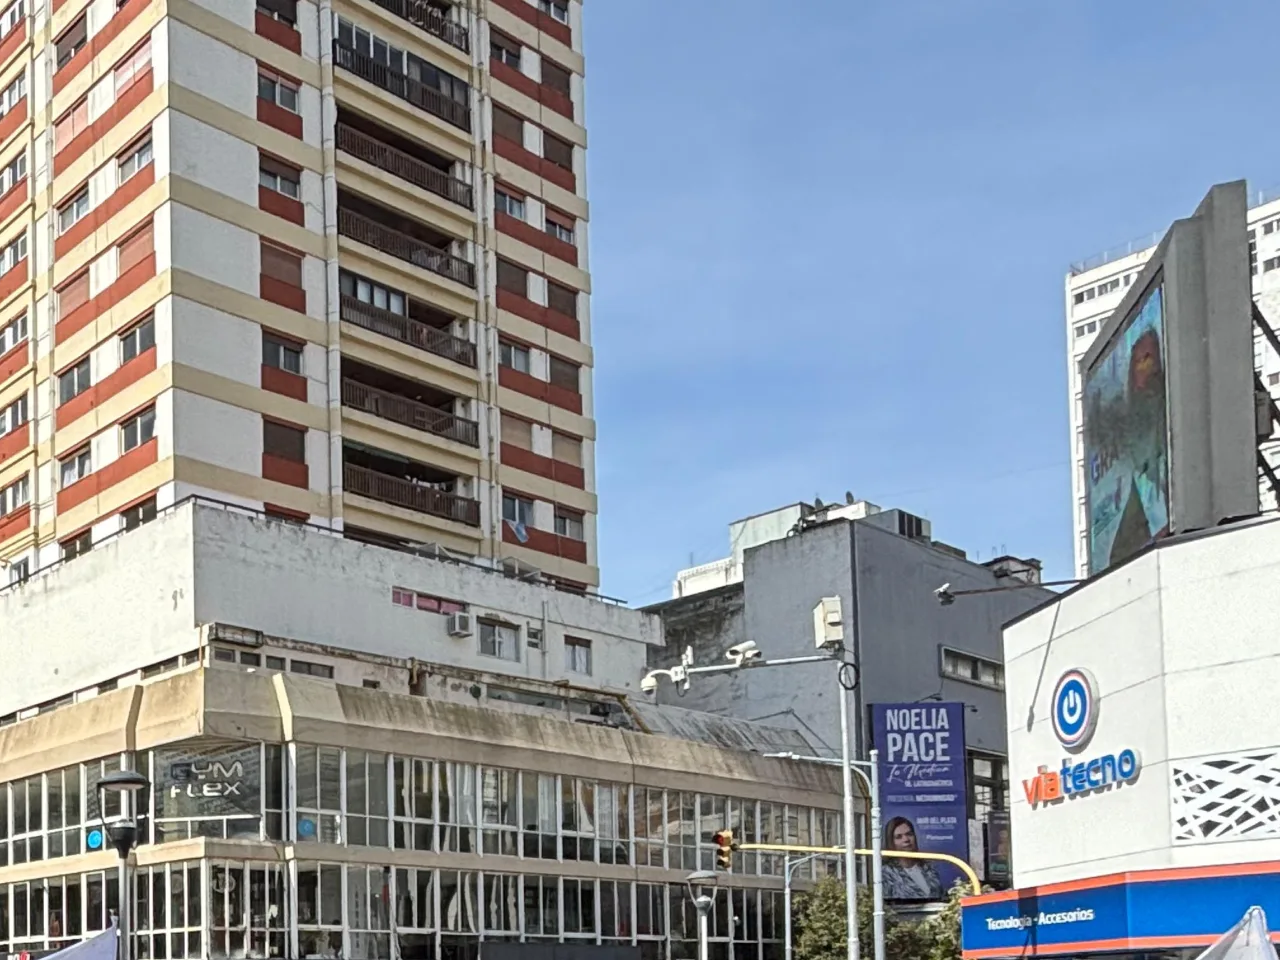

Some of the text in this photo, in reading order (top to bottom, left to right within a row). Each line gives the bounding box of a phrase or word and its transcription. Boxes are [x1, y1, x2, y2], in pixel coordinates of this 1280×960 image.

[886, 708, 949, 731] NOELIA
[887, 732, 950, 762] PACE
[1038, 907, 1095, 926] Accesorios
